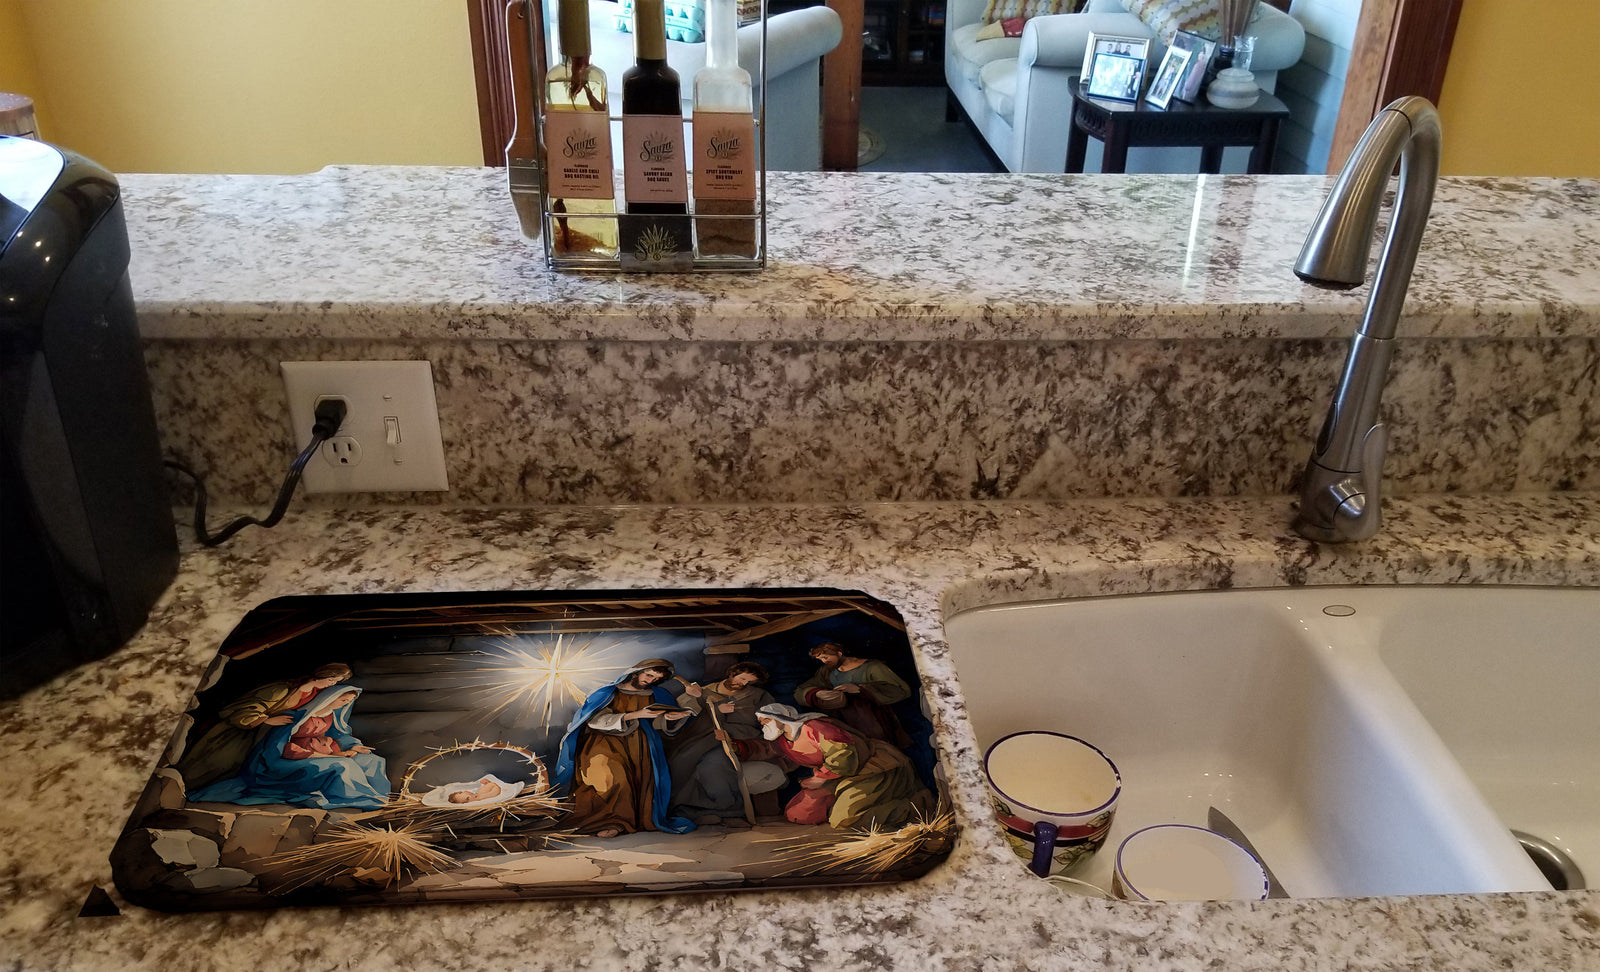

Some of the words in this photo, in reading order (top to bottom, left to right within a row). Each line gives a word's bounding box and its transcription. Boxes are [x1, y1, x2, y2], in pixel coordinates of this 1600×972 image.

[562, 135, 598, 158] Sauza
[639, 139, 674, 161] Sauza
[706, 136, 741, 159] Sauza
